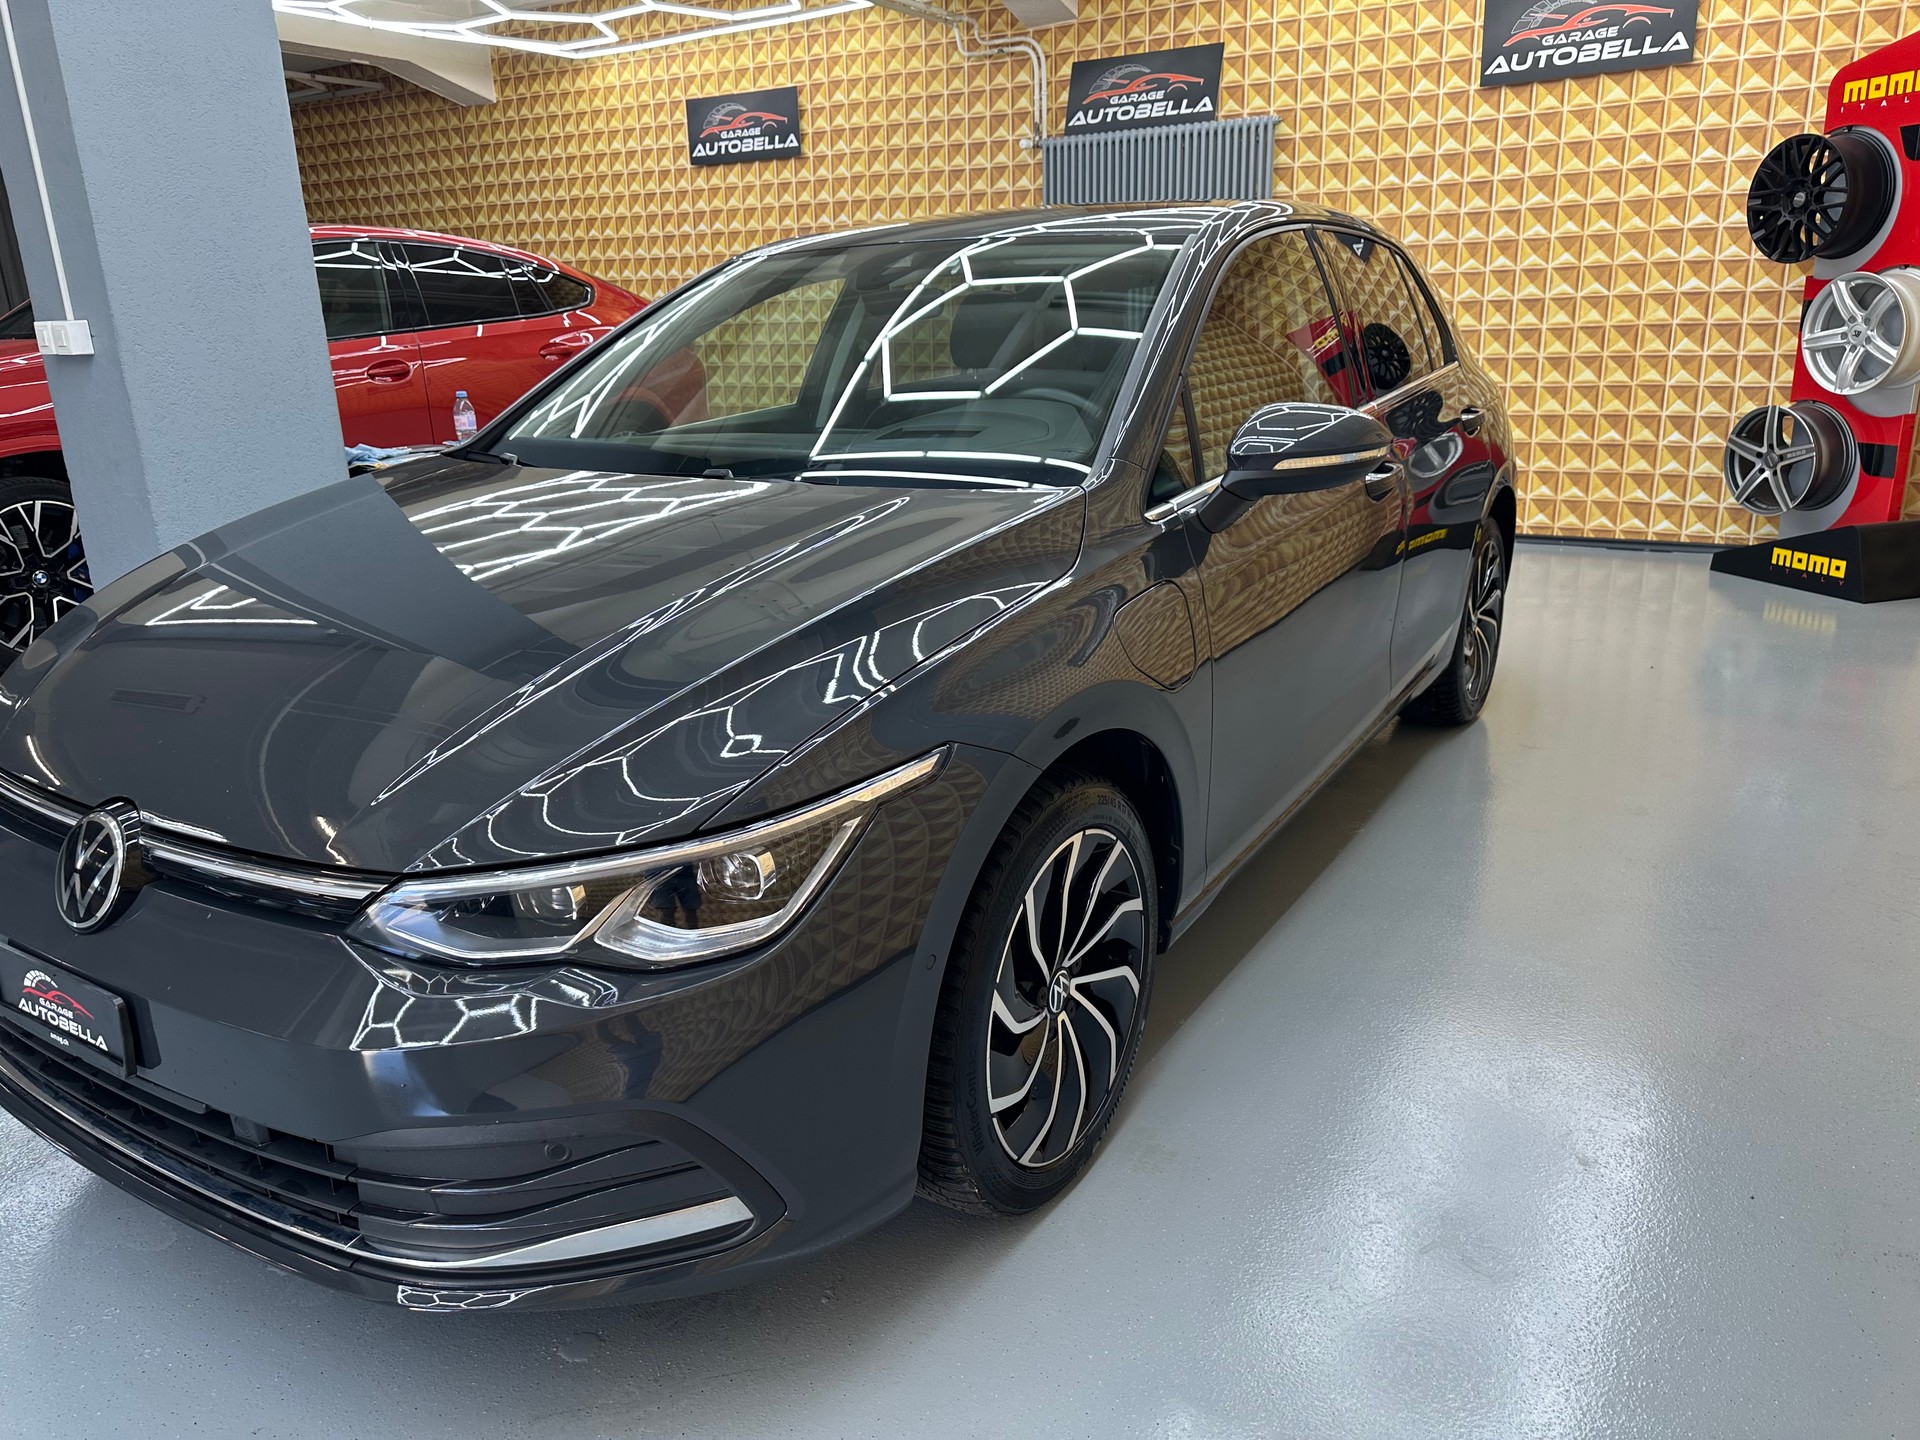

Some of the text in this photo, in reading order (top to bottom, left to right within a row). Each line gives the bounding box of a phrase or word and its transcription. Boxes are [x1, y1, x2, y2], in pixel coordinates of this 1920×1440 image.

[1541, 25, 1620, 46] GARAGE
[1484, 31, 1690, 75] AUTOBELLA
[1109, 90, 1166, 105] GARAGE
[1842, 69, 1920, 104] mom
[1068, 95, 1214, 127] AUTOBELLA
[720, 127, 762, 139] GARAGE
[692, 133, 799, 157] AUTOBELLA
[1769, 565, 1845, 586] ITALY
[38, 997, 74, 1019] GARAGE
[18, 997, 109, 1052] AUTOBELLA
